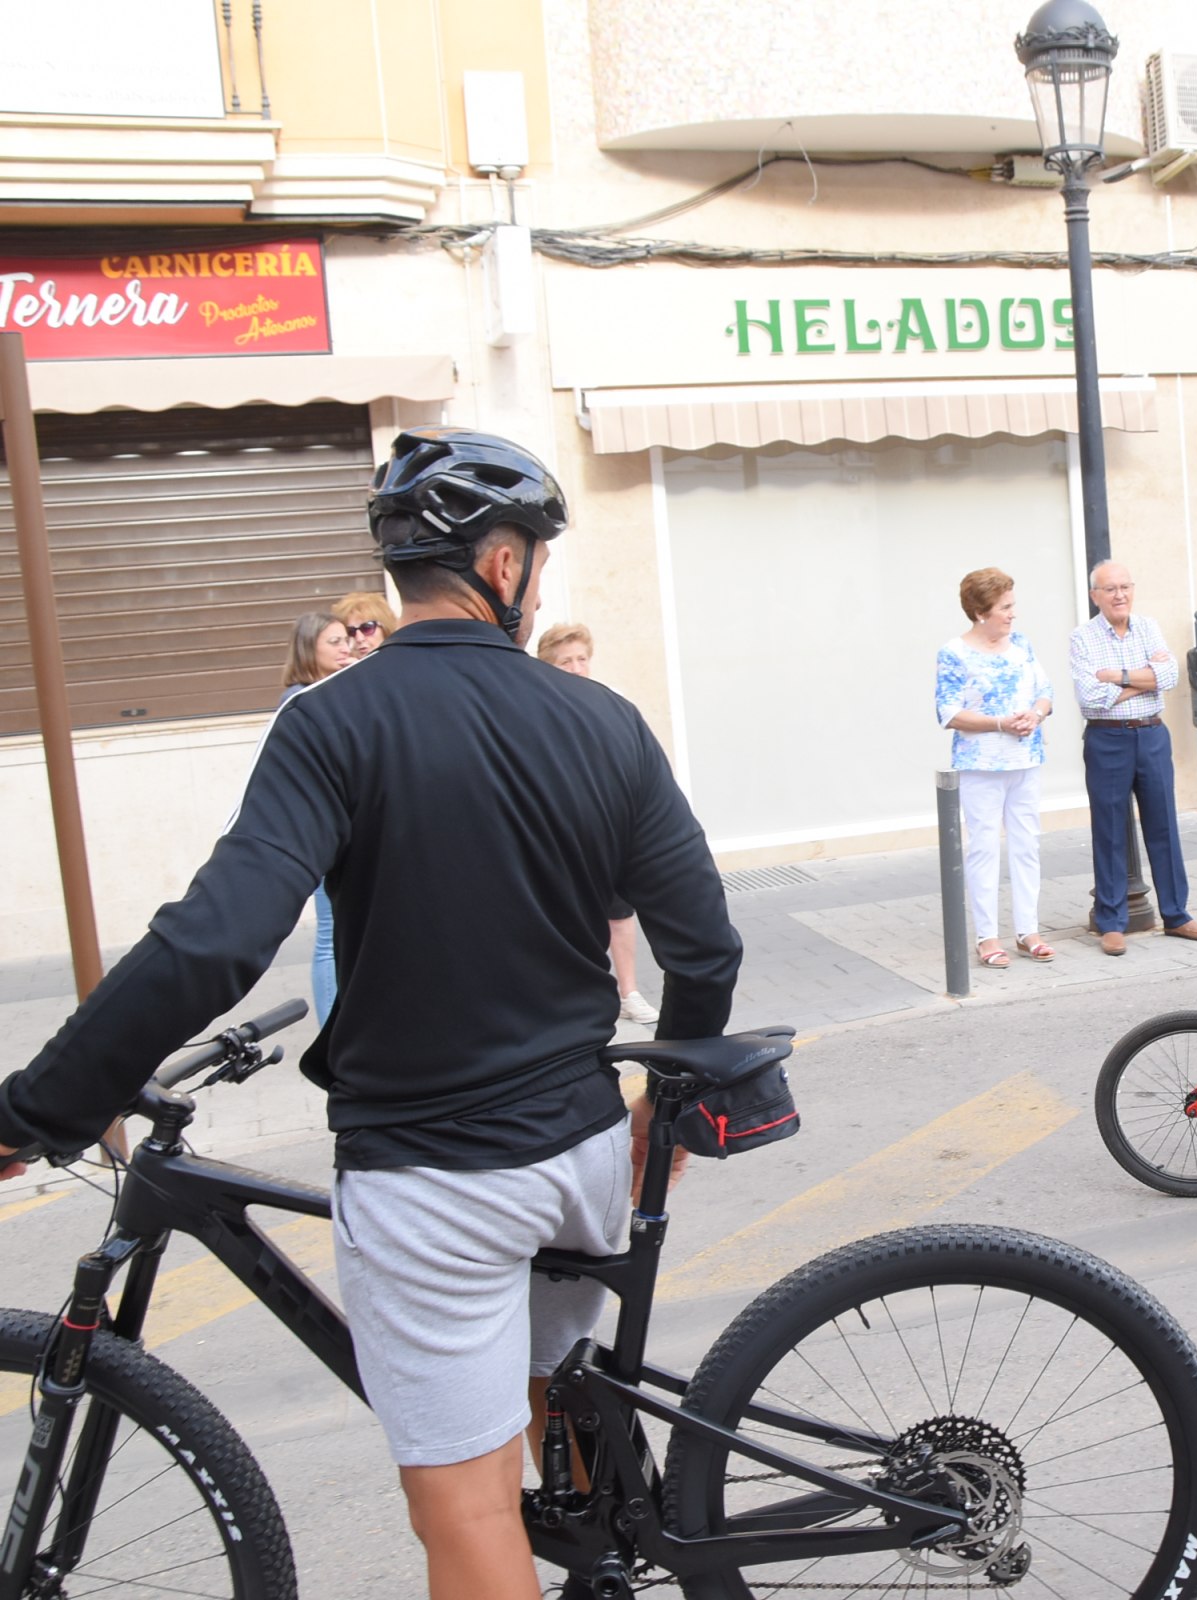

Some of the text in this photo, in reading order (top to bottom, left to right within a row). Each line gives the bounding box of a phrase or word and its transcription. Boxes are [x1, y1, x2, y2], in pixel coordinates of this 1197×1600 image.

[101, 244, 317, 279] CARNICERÍA
[0, 272, 188, 328] Ternera
[199, 294, 280, 327] Productos
[234, 315, 317, 345] Artesanos
[725, 296, 1077, 355] HELADOS
[155, 1423, 244, 1544] MAXXIS
